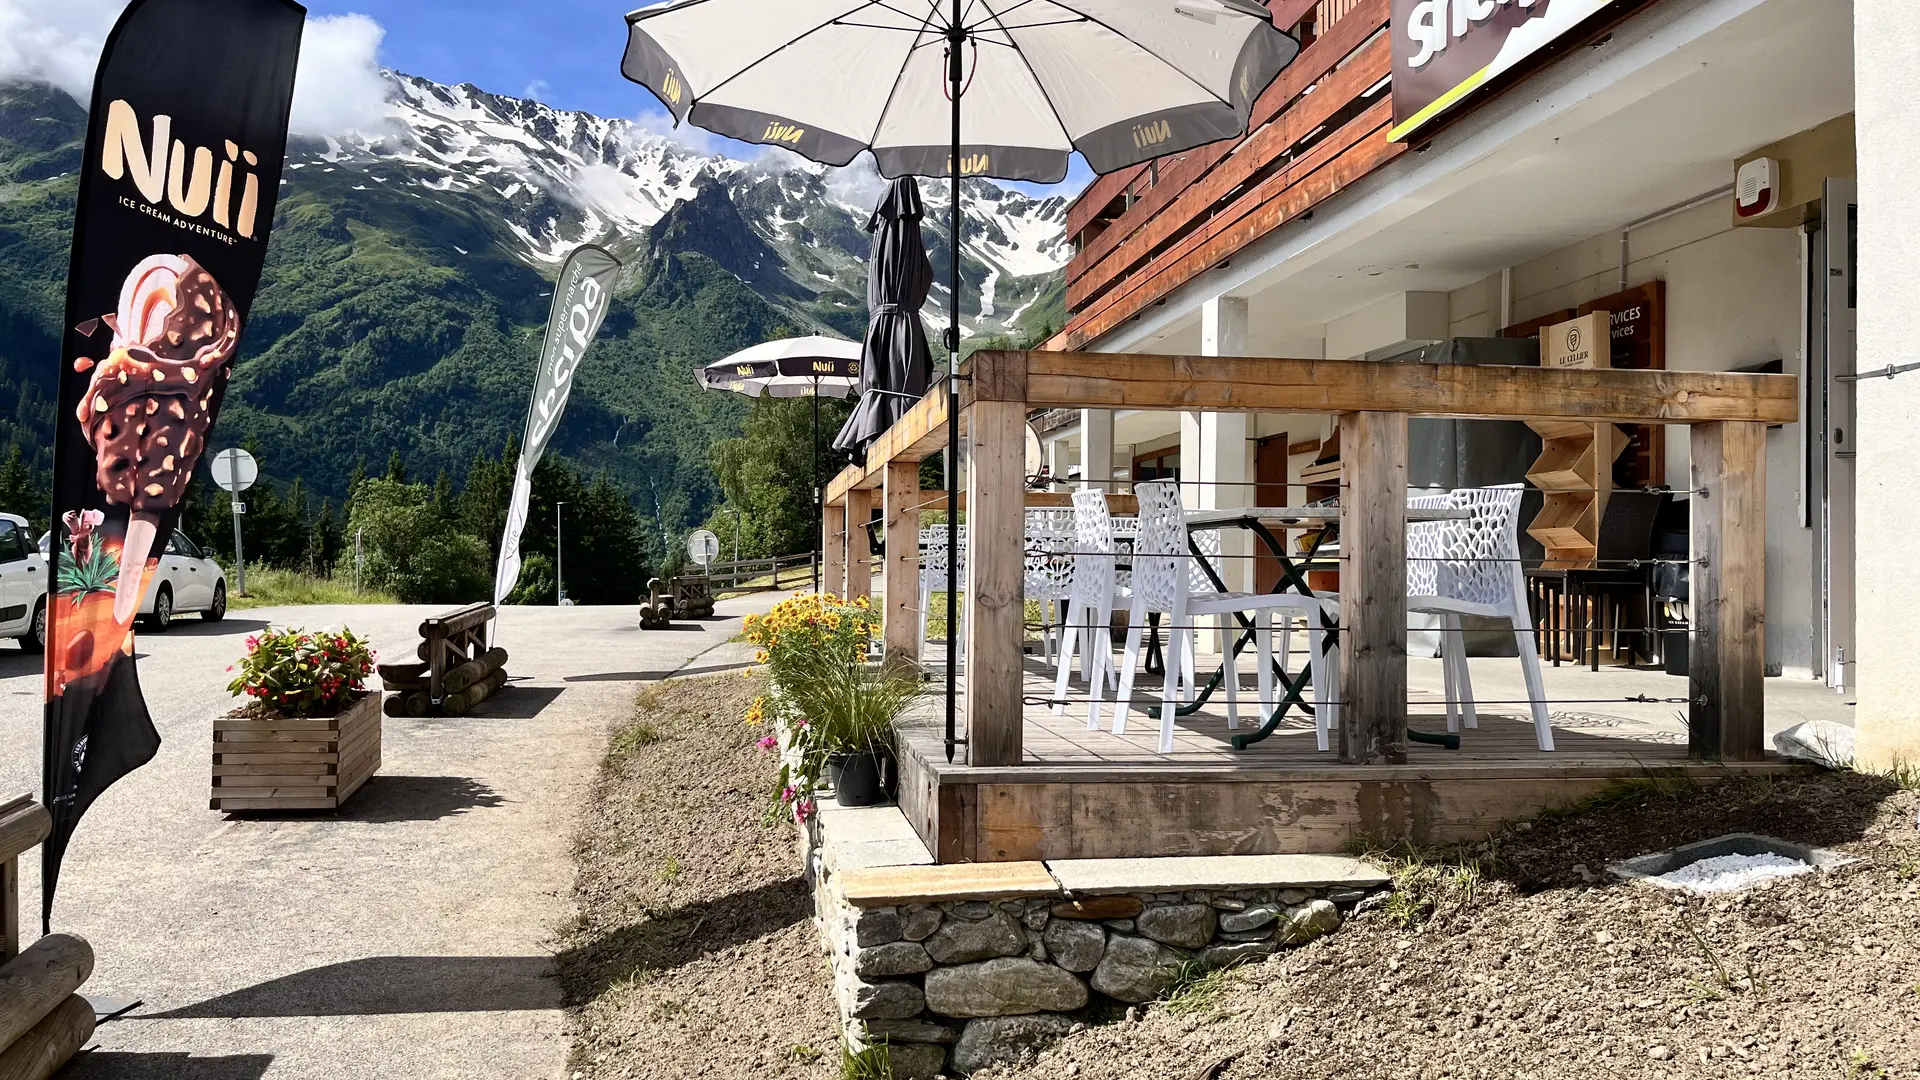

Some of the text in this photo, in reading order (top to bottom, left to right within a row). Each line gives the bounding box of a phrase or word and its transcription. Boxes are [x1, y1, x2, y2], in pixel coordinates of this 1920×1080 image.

[102, 99, 259, 238] Nuii
[118, 196, 136, 209] ICE
[139, 204, 171, 223] CREAM
[566, 261, 583, 307] marché
[1609, 306, 1641, 326] RVICES
[812, 361, 835, 373] Nuii
